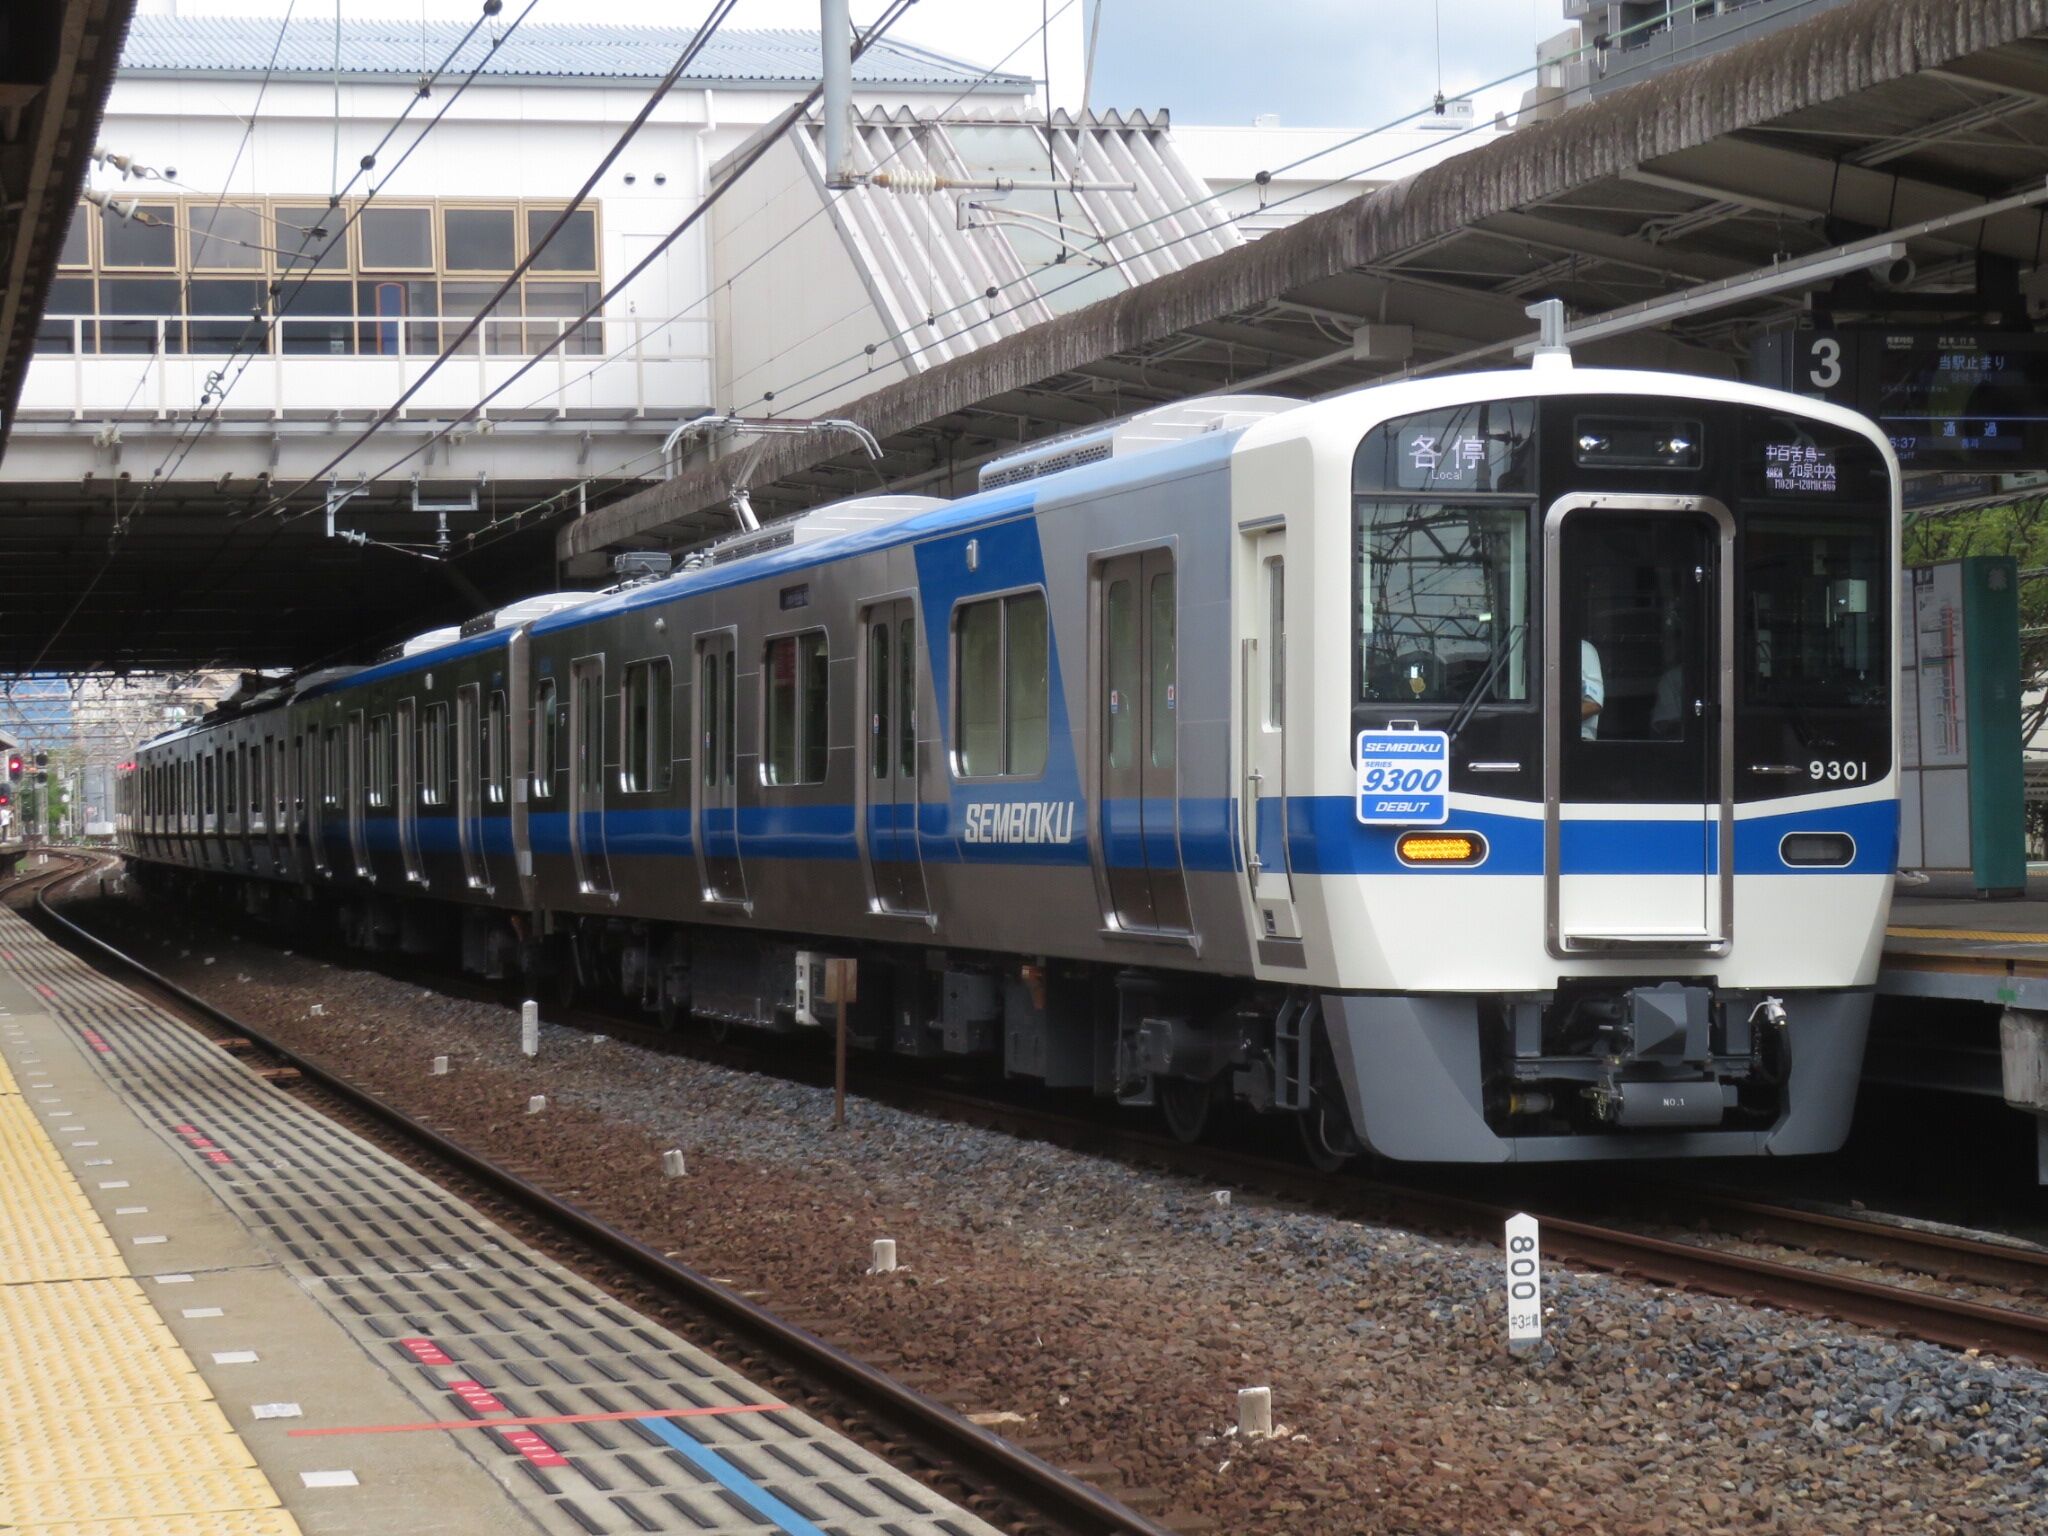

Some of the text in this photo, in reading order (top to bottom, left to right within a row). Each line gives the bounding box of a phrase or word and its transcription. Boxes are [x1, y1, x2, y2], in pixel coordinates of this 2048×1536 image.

[1809, 338, 1842, 388] 3
[1939, 354, 2005, 370] 当駅止まり
[1408, 434, 1486, 470] 各停
[1431, 469, 1463, 481] Local
[1789, 462, 1836, 479] 和泉中央
[1364, 742, 1442, 753] SEMBOKU
[1362, 768, 1443, 793] 9300
[1809, 760, 1867, 781] 9301
[1375, 801, 1431, 813] DEBUT
[964, 801, 1075, 844] SEMBOKU
[1510, 1236, 1536, 1300] 800
